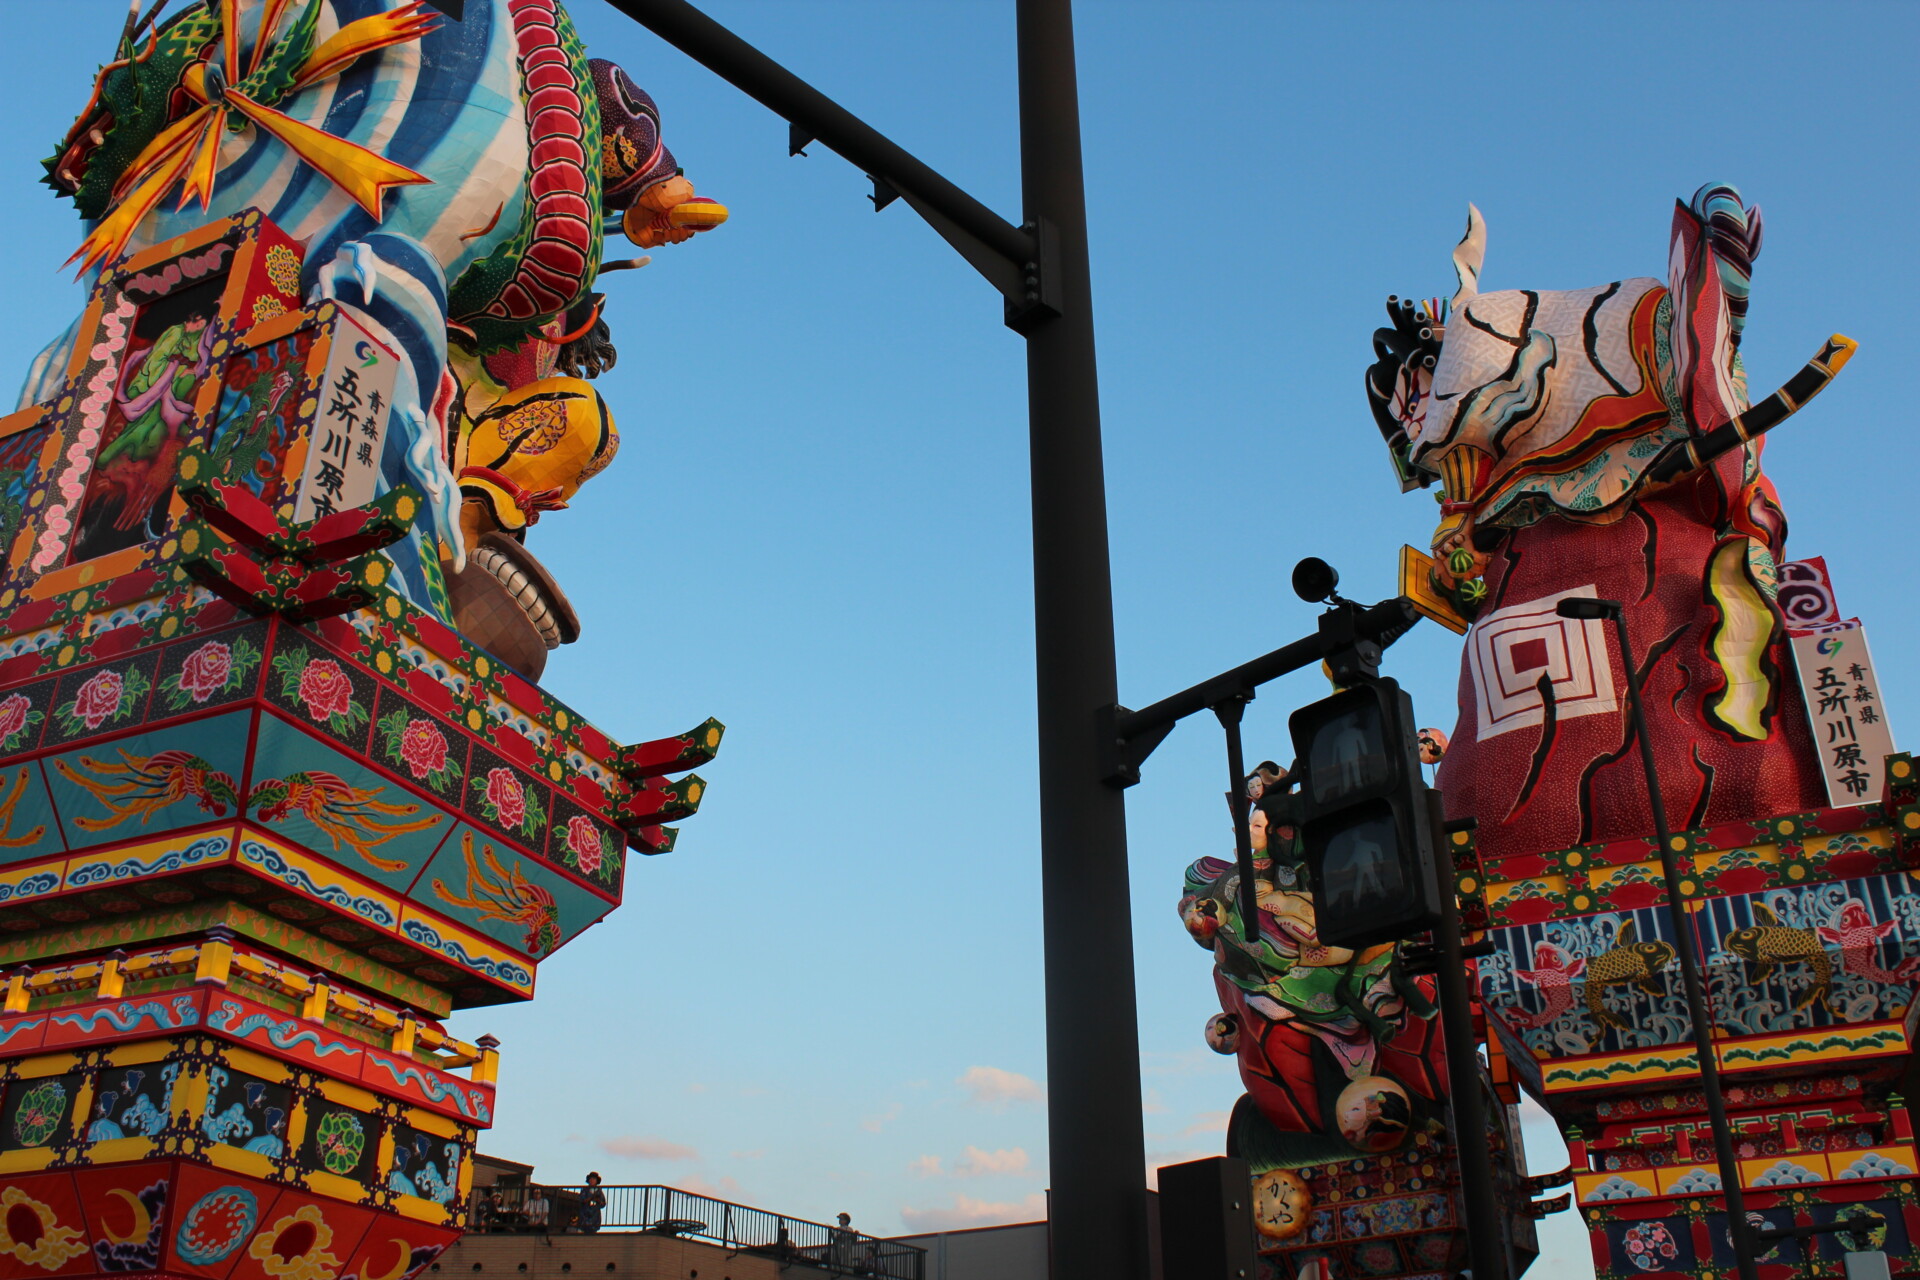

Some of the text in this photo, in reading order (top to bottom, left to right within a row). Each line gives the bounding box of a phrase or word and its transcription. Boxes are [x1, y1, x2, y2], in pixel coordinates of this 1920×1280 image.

[357, 388, 386, 469] 青森県
[1812, 666, 1871, 798] 五所川原市
[1846, 662, 1880, 725] 青森県
